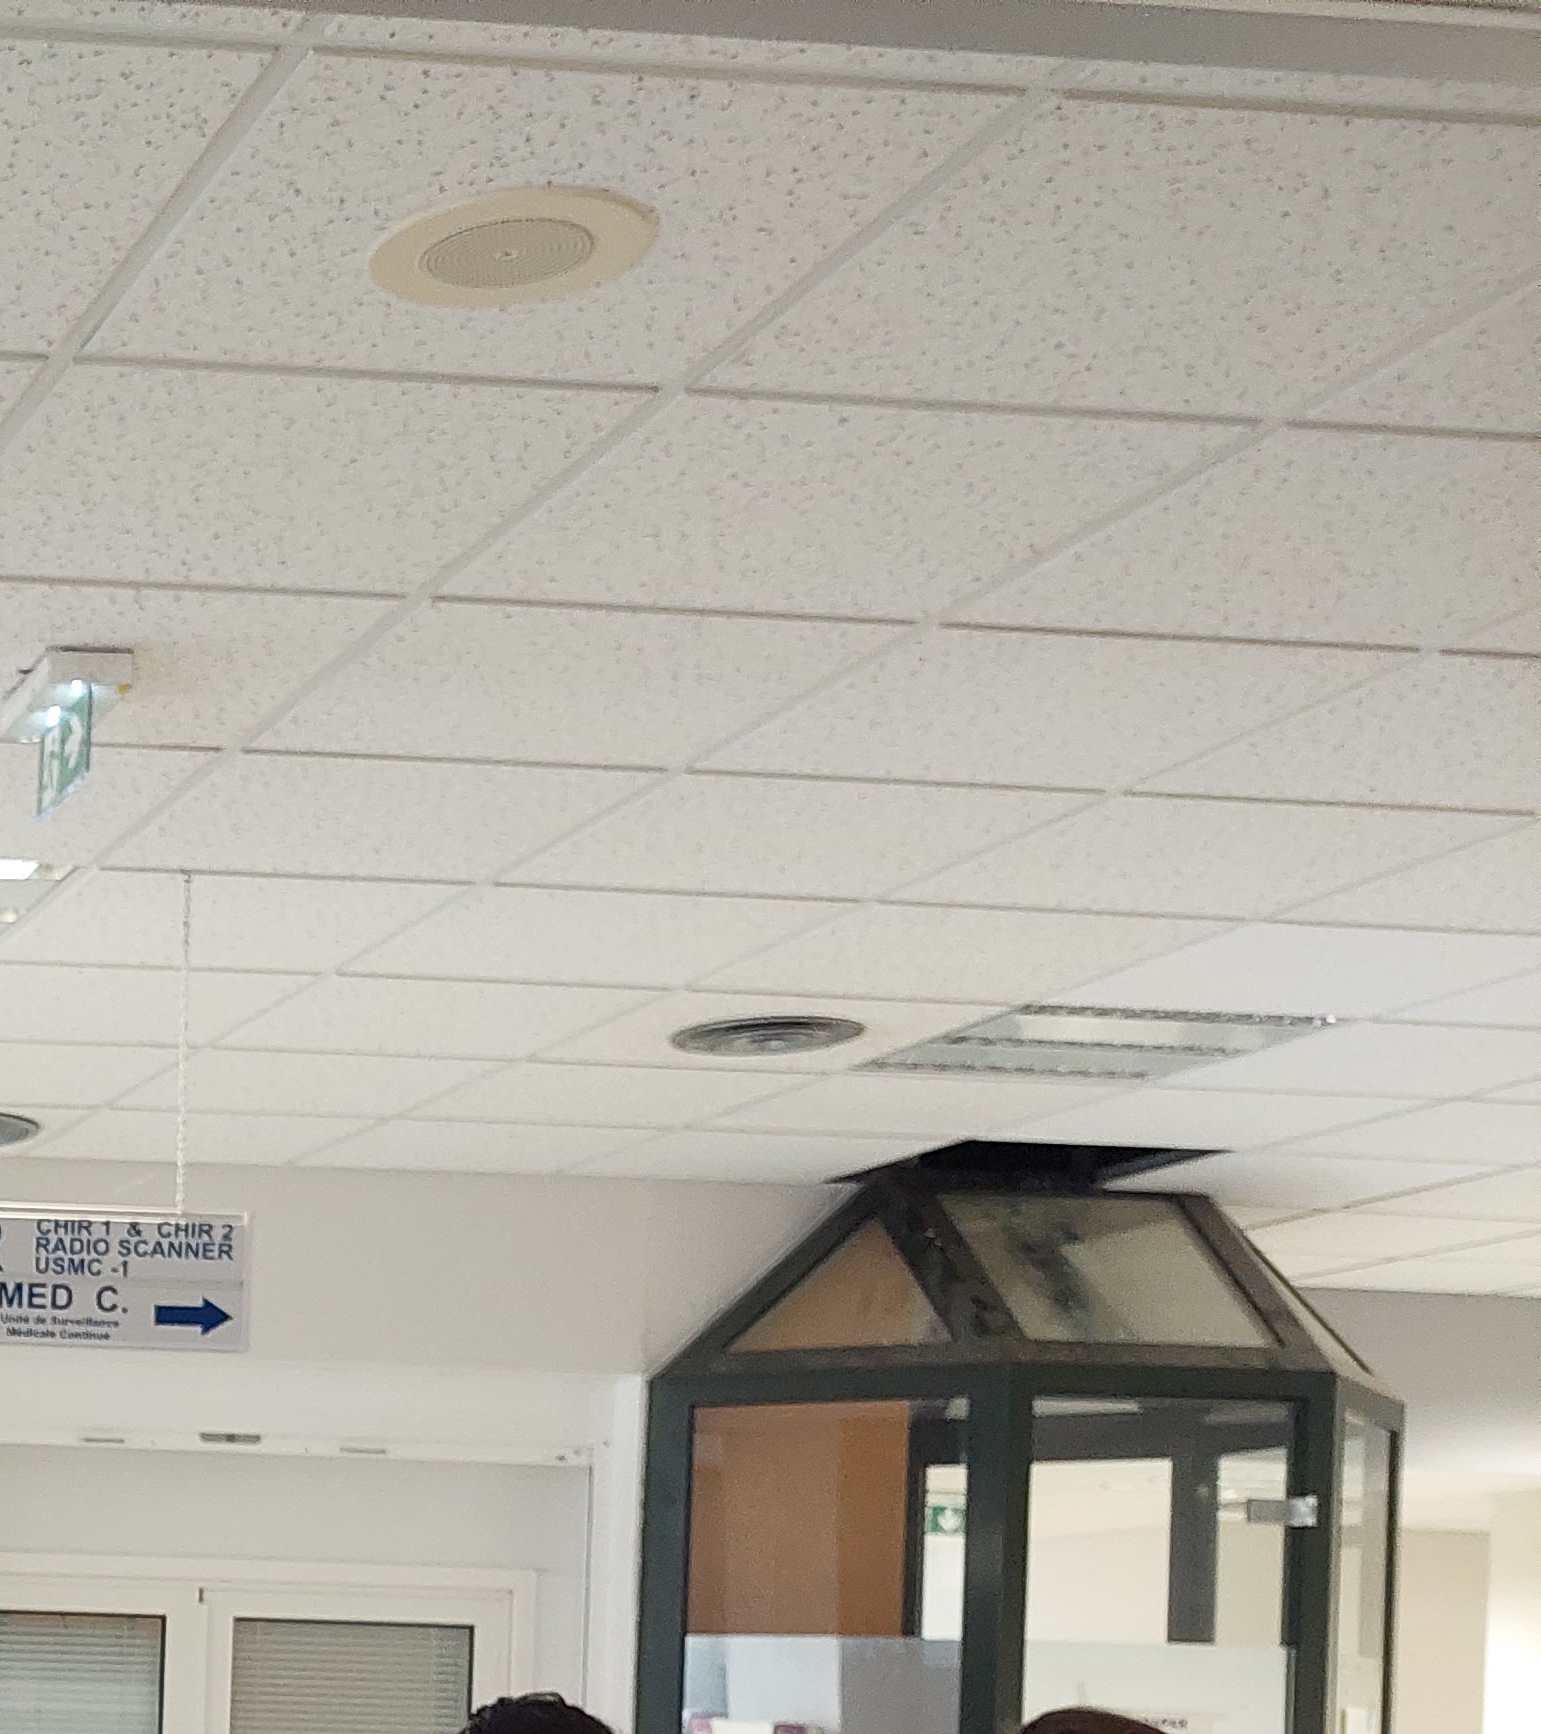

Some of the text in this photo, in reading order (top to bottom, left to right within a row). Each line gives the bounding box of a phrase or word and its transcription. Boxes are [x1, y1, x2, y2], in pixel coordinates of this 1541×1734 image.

[36, 1219, 234, 1242] CHIR 1 & CHIR 2
[35, 1237, 234, 1261] RADIO SCANNER
[35, 1257, 103, 1277] USMC
[95, 1285, 129, 1314] C.
